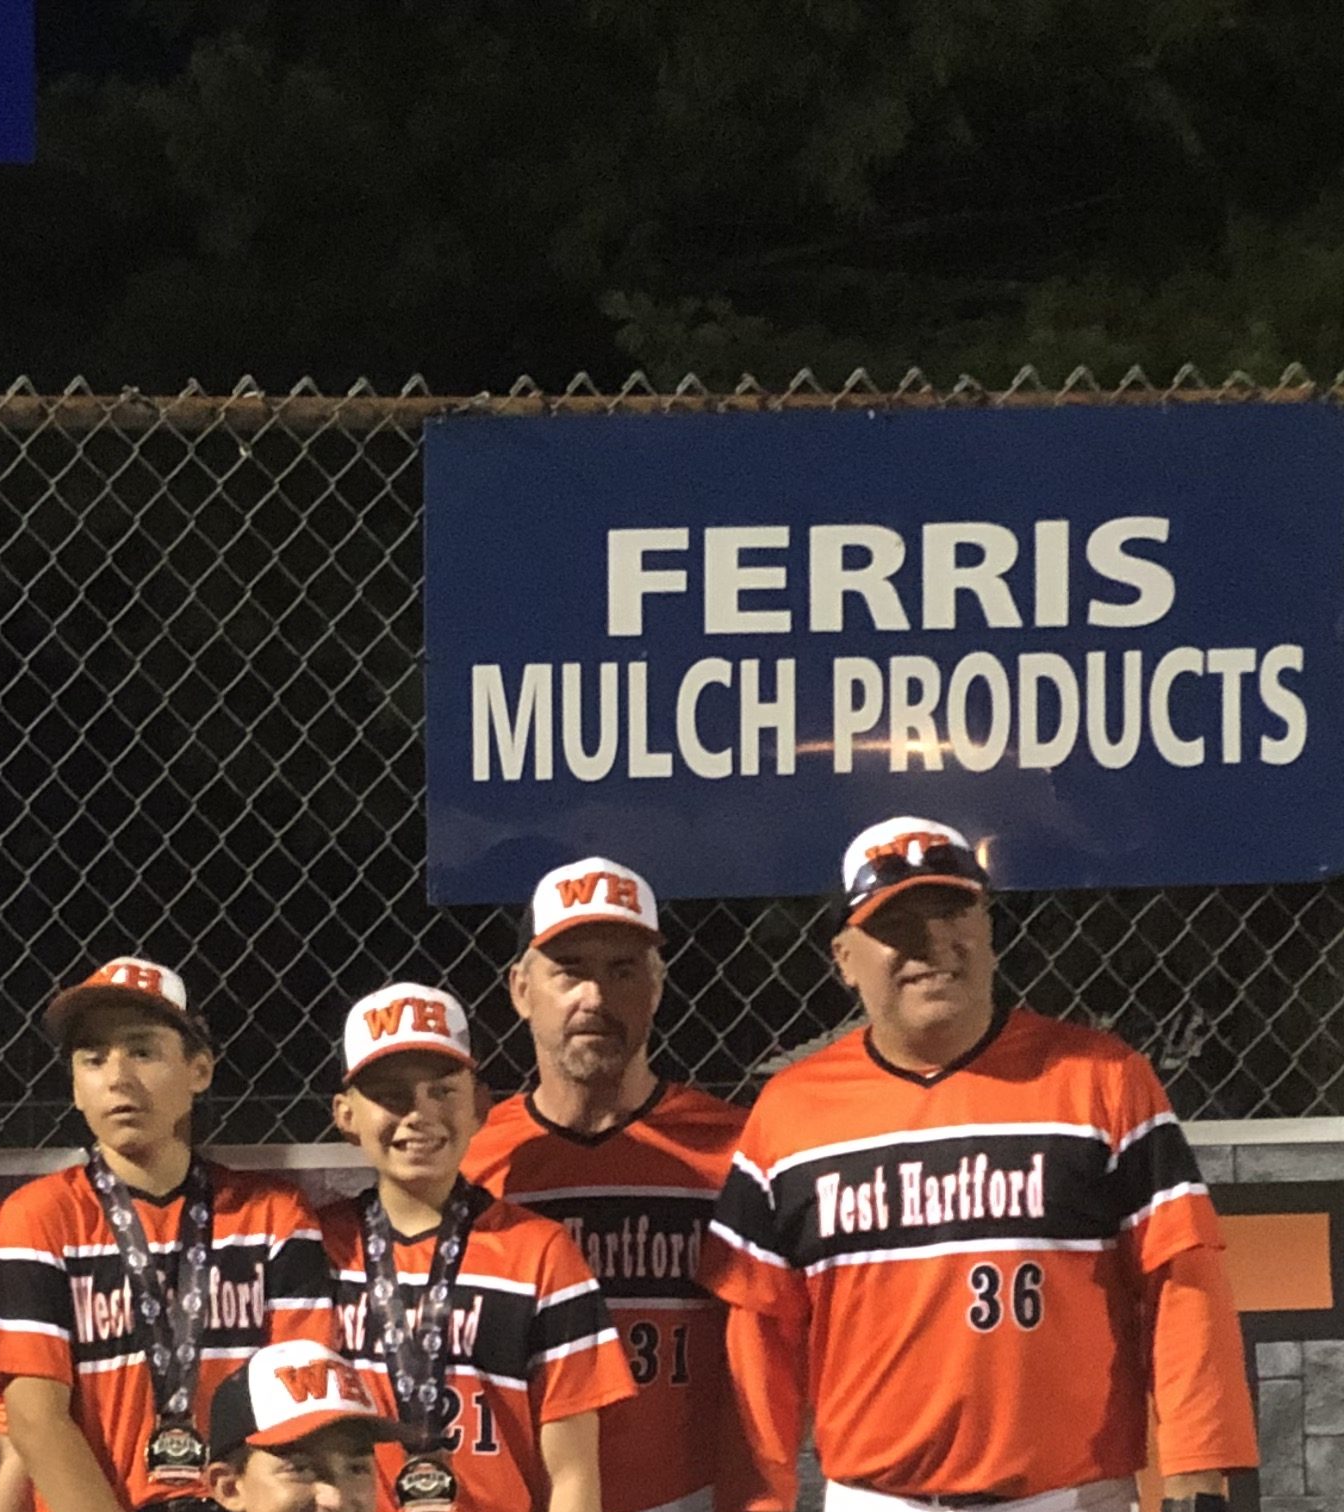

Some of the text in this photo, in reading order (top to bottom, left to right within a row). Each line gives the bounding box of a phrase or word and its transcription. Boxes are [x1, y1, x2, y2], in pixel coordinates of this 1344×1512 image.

[606, 516, 1177, 638] FERRIS
[471, 643, 1309, 783] MULCH PRODUCTS
[555, 872, 642, 914] WH
[363, 997, 451, 1040] WH
[816, 1153, 1045, 1238] West Hartford
[967, 1260, 1045, 1333] 36
[628, 1319, 690, 1388] 31
